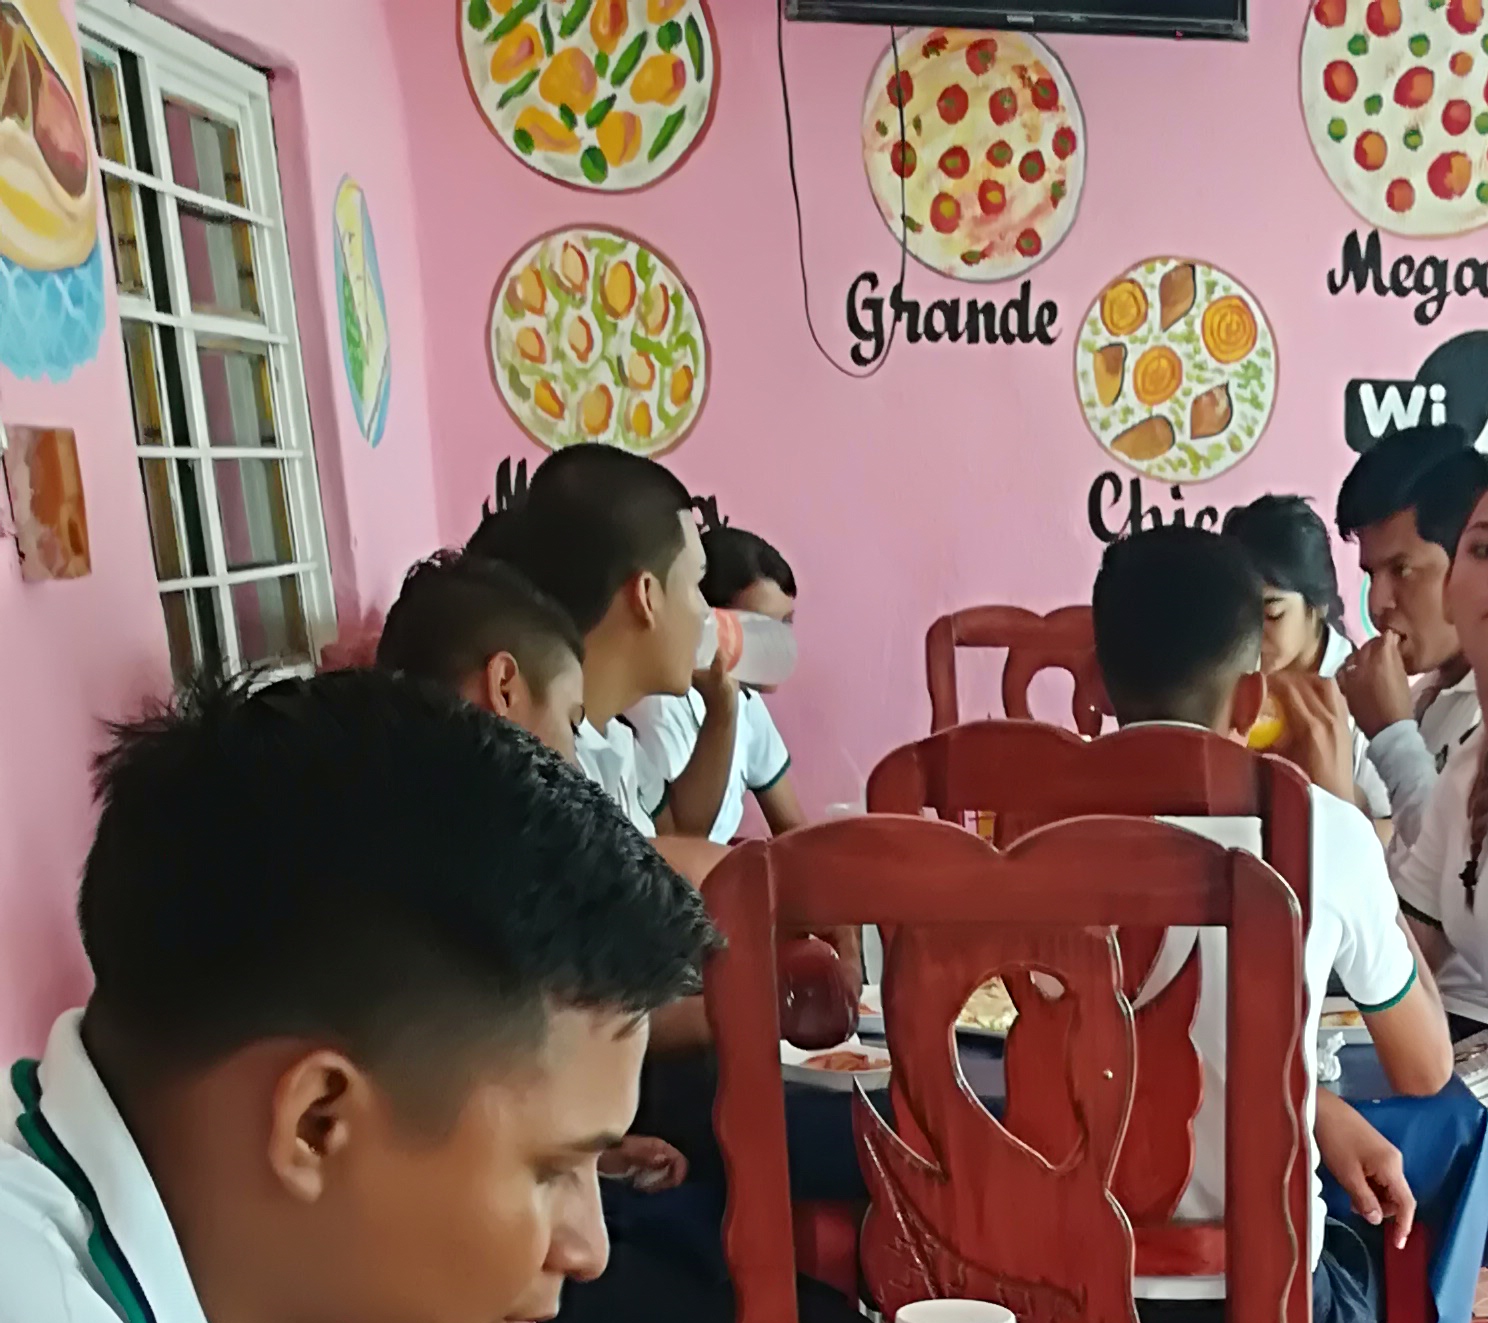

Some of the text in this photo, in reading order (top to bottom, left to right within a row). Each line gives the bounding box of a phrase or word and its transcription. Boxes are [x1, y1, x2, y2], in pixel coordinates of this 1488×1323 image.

[846, 271, 1062, 366] Grande
[1359, 383, 1446, 437] Wi
[1088, 471, 1219, 543] Chic
